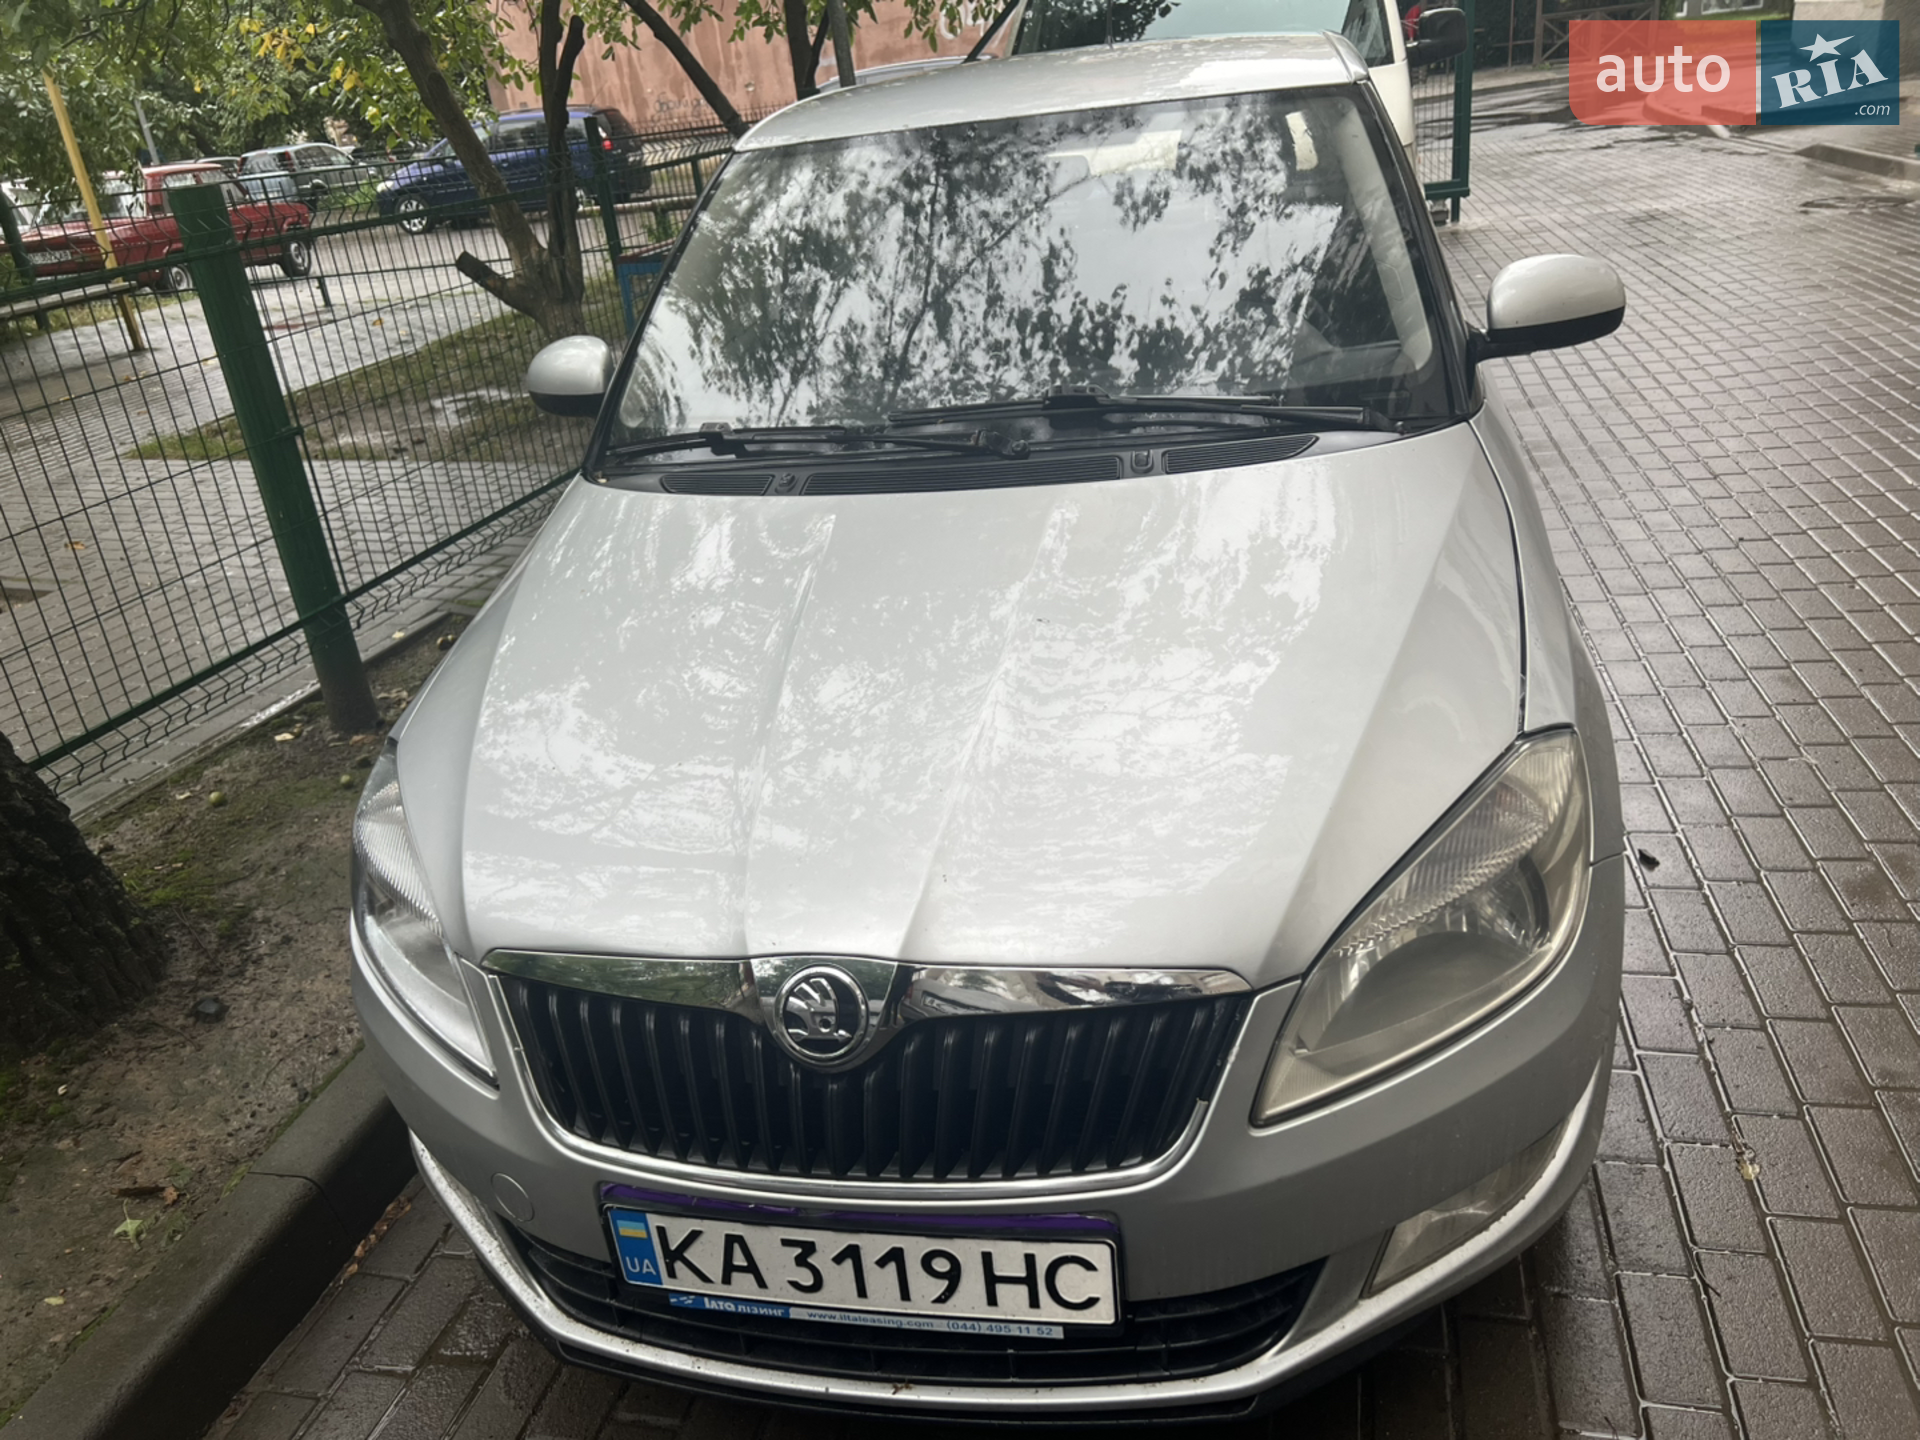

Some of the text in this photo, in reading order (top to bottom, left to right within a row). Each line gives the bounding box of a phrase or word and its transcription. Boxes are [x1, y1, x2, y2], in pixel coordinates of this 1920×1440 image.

[625, 1256, 657, 1276] UA
[656, 1225, 1101, 1311] KA 3119 HC
[946, 1320, 982, 1332] (044)
[986, 1321, 1012, 1334] 495
[1016, 1325, 1031, 1335] 11
[1036, 1326, 1053, 1336] 52
